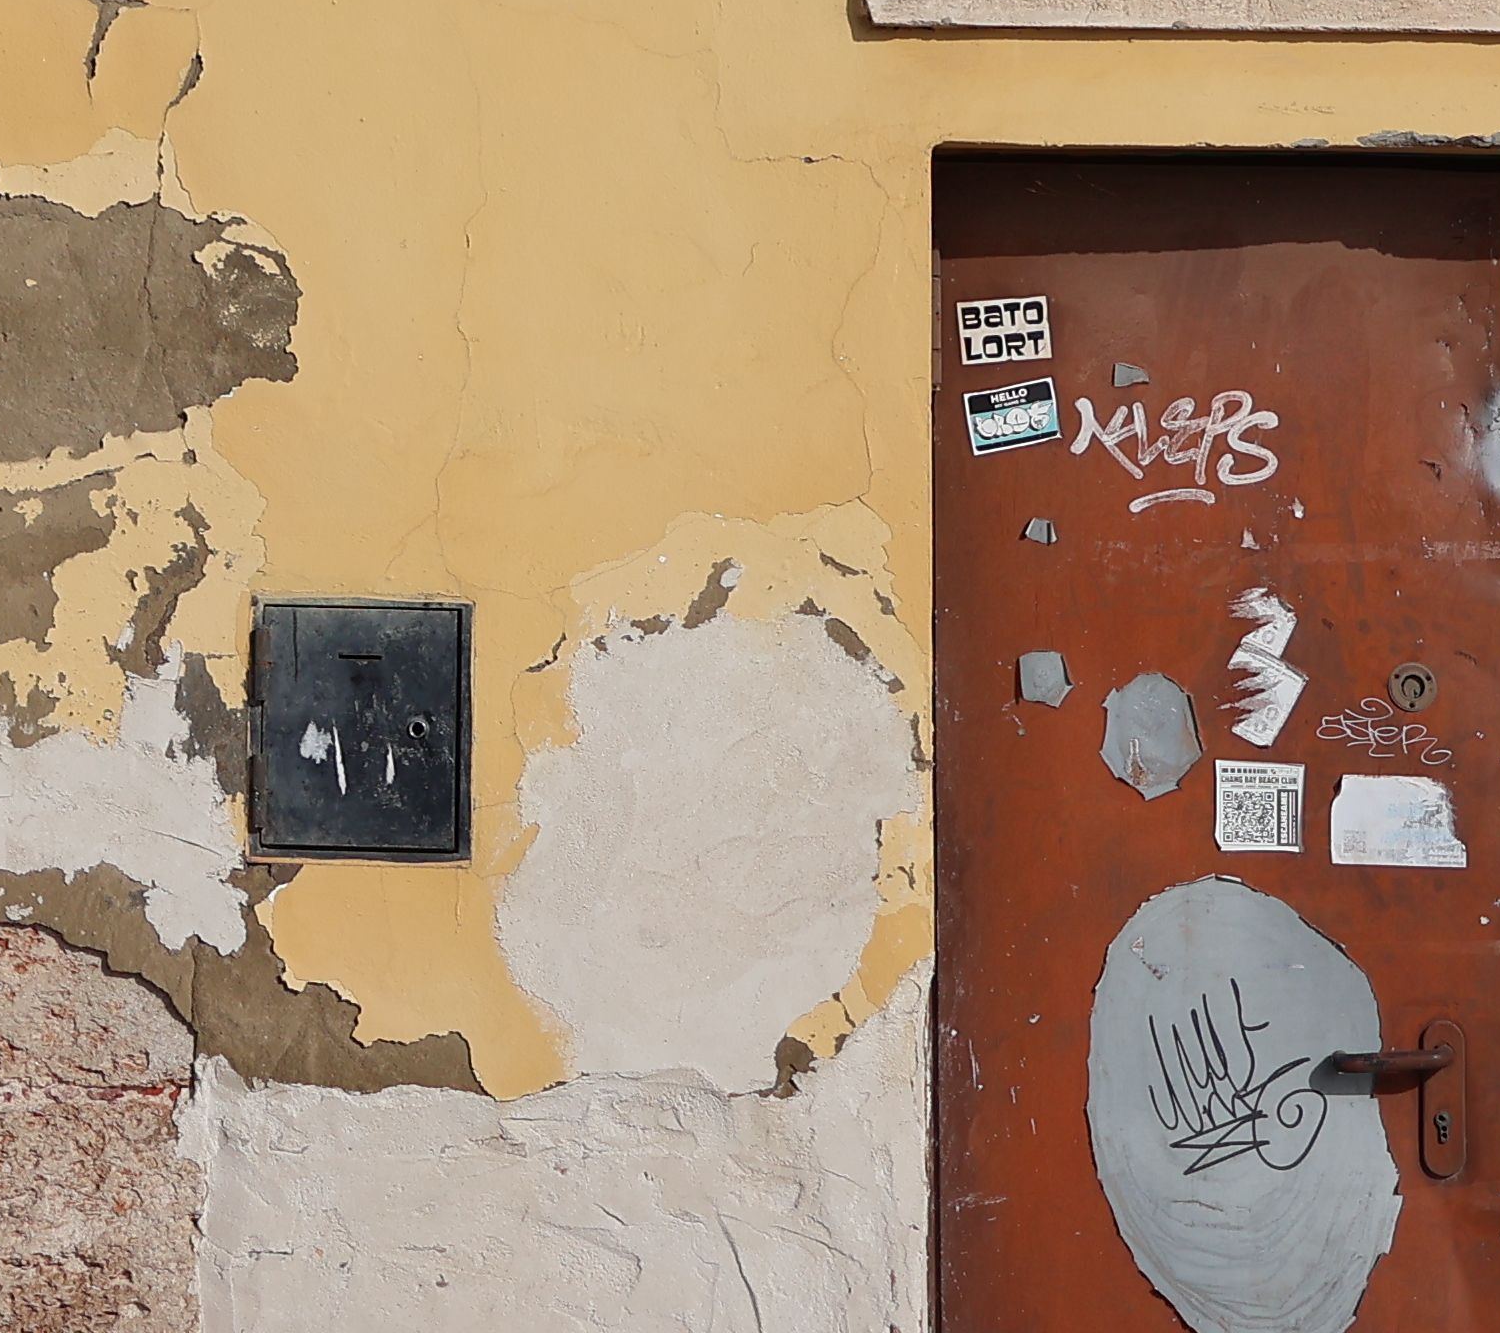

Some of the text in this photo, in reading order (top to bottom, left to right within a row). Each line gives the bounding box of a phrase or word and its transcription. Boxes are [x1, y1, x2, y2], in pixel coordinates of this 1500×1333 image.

[963, 331, 1045, 361] LORT
[990, 388, 1028, 403] HELLO
[1245, 776, 1257, 784] BAY
[1258, 776, 1279, 784] BEACH
[1281, 777, 1297, 785] CLUB
